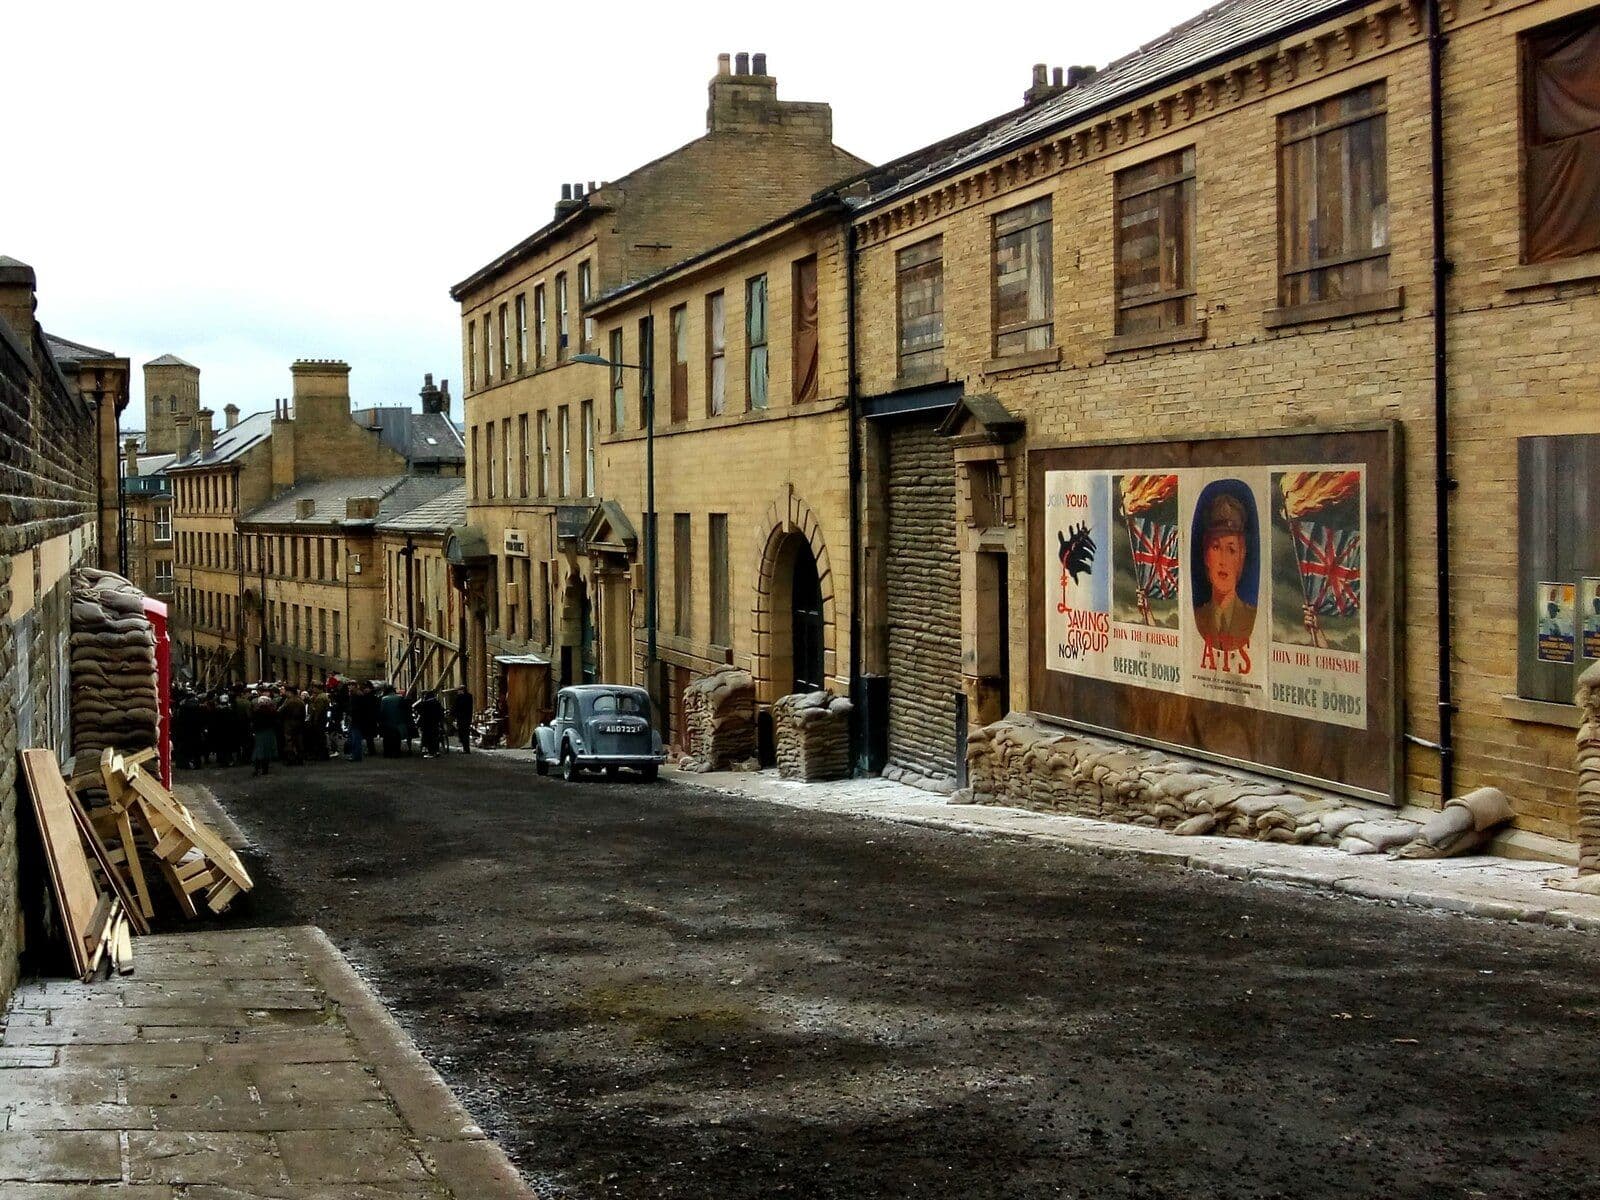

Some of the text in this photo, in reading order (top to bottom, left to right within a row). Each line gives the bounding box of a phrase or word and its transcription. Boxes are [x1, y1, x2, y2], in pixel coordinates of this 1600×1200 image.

[1065, 493, 1088, 508] YOUR
[1067, 609, 1110, 633] SAVINGS
[1067, 629, 1109, 653] GROUP
[1131, 629, 1143, 643] THE
[1113, 656, 1148, 677] DEFENCE
[1151, 662, 1180, 683] BONDS
[1296, 652, 1310, 667] THE
[1315, 655, 1361, 675] CRUSADE
[1272, 682, 1317, 708] DEFENCE
[1322, 690, 1361, 716] BONDS
